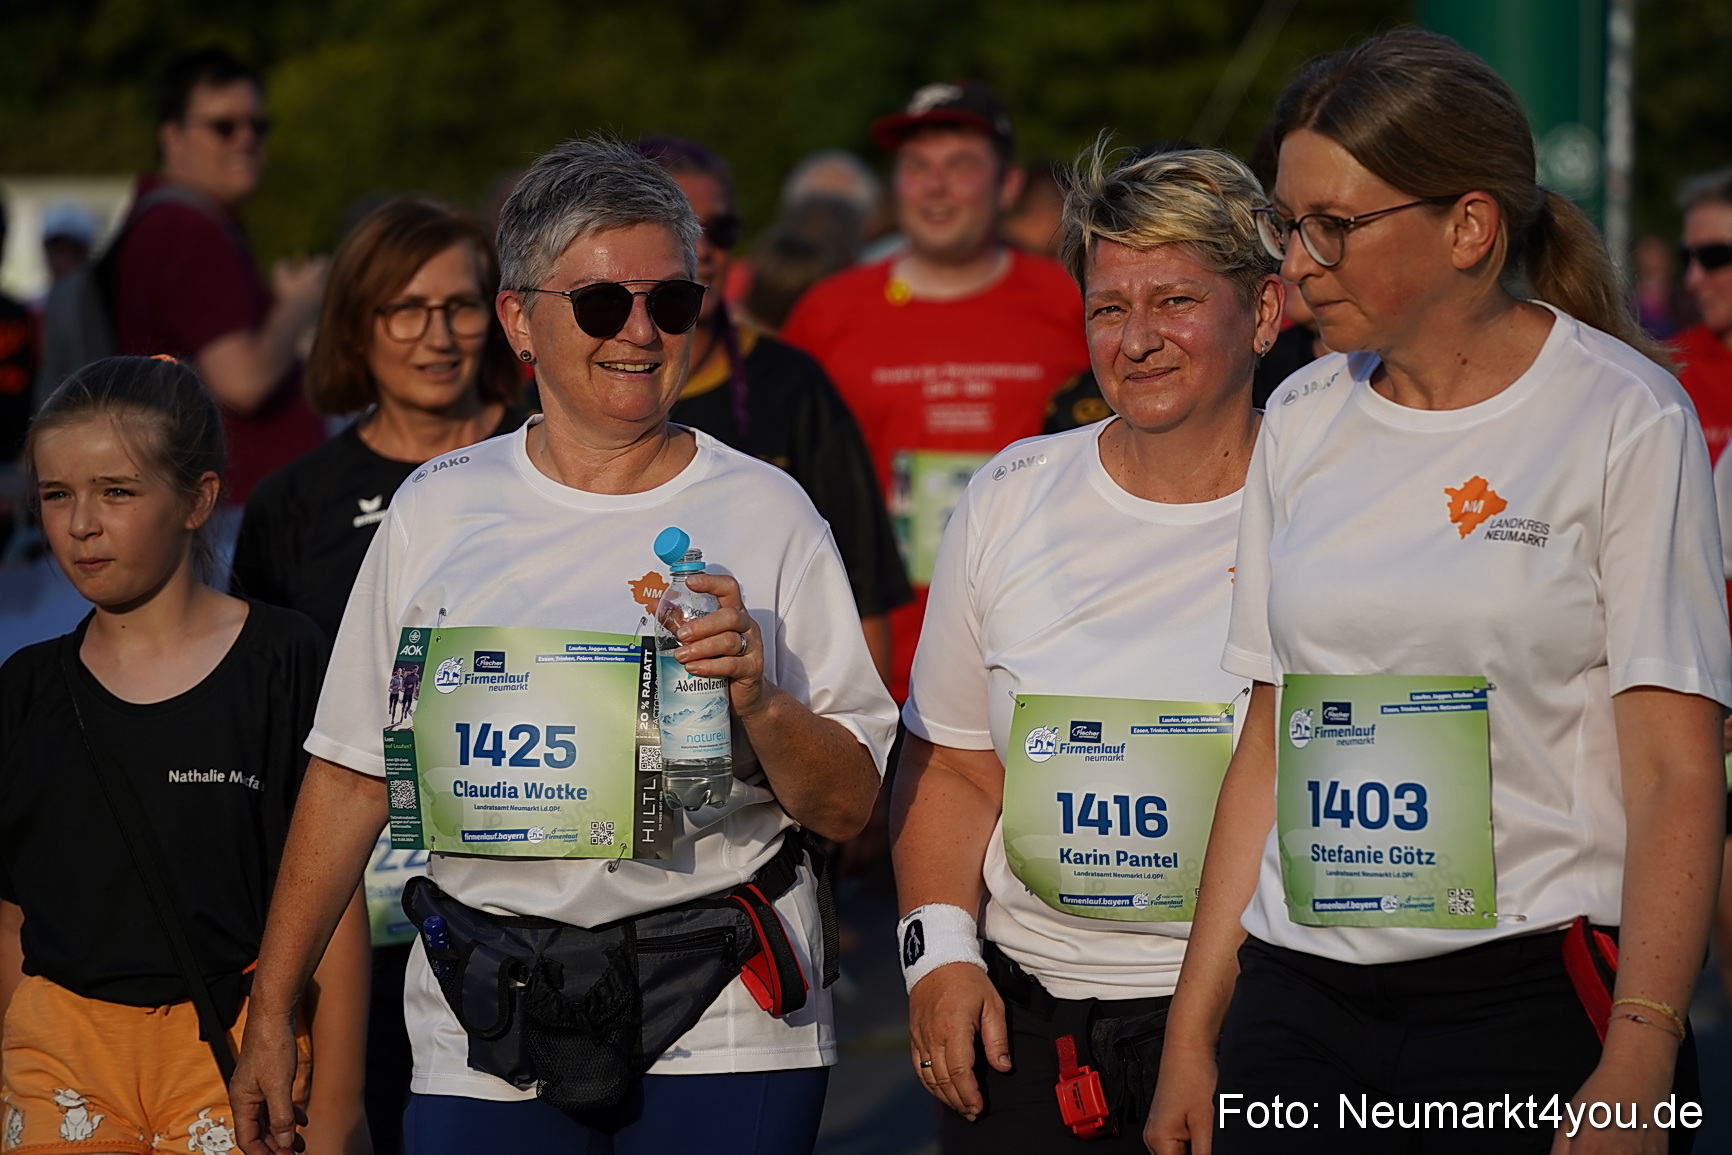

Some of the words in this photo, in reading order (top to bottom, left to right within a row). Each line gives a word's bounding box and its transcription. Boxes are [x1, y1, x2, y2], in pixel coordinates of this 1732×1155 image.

[432, 456, 470, 473] JAKO
[1011, 454, 1048, 472] JAKO
[1489, 518, 1551, 535] LANDKREIS
[1484, 530, 1548, 548] NEUMARKT
[642, 587, 663, 599] NM
[400, 645, 424, 656] AOK
[476, 655, 504, 666] Fischer
[464, 672, 530, 685] Firmenlauf
[641, 649, 653, 698] RABATT
[488, 683, 528, 692] neumarkt
[641, 700, 650, 710] %
[640, 712, 649, 730] 20
[686, 729, 727, 743] naturell
[1072, 725, 1100, 737] Fischer
[1315, 724, 1376, 738] Firmenlauf
[455, 722, 577, 769] 1425
[1059, 743, 1126, 754] Firmenlauf
[1336, 737, 1375, 746] neumarkt
[1085, 754, 1124, 762] neumarkt
[168, 769, 226, 783] Nathalie
[453, 779, 519, 798] Claudia
[524, 782, 588, 800] Wotke
[642, 778, 656, 842] HILTL
[1307, 780, 1428, 831] 1403
[1056, 792, 1169, 839] 1416
[464, 832, 525, 842] firmenlauf.bayern
[1059, 848, 1111, 866] Karin
[1116, 850, 1179, 868] Pantel
[1311, 843, 1384, 864] Stefanie
[1389, 846, 1436, 866] Götz
[1062, 896, 1130, 907] firmenlauf.bayern
